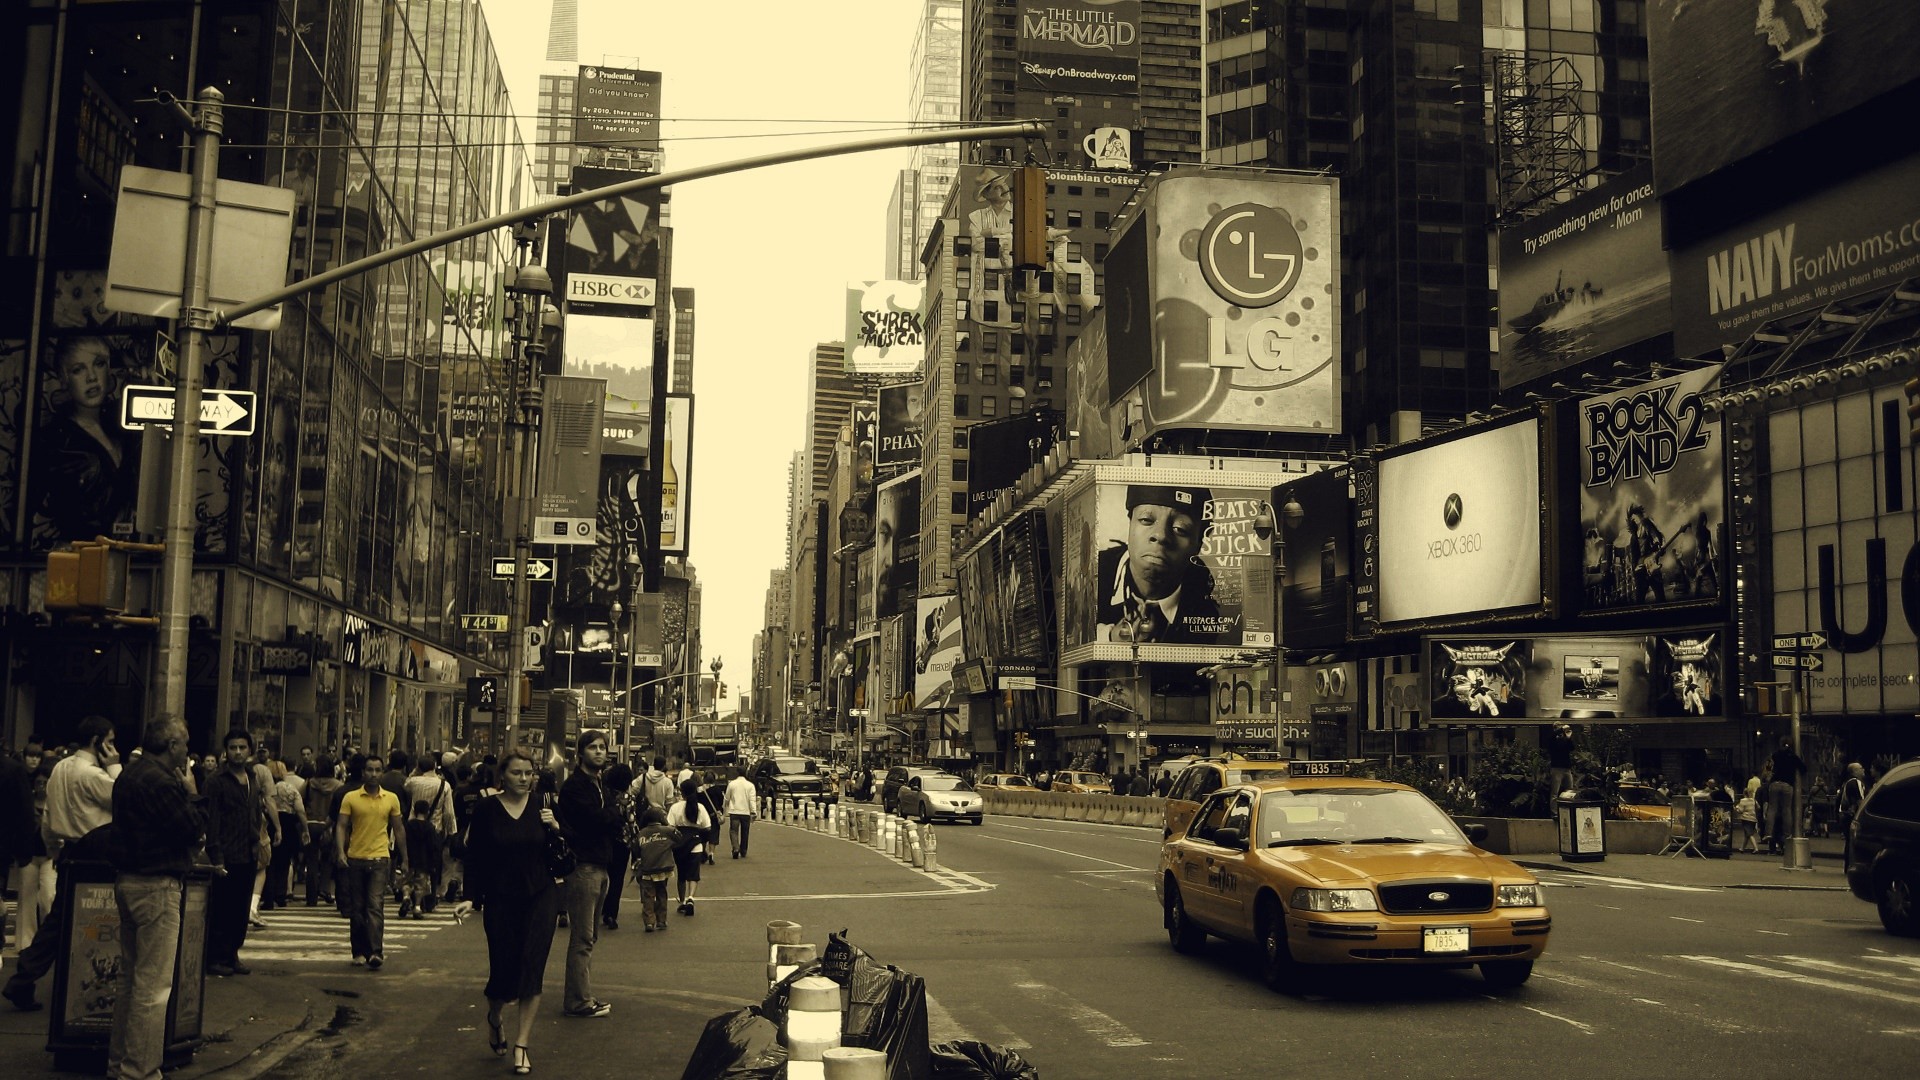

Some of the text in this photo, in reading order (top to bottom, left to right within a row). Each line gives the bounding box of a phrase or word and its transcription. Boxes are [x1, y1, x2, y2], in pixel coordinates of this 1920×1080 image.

[1046, 7, 1115, 25] THE LITTLE
[1023, 14, 1136, 51] MERMAID
[599, 70, 635, 81] Prudential
[588, 87, 603, 95] Did
[623, 91, 649, 99] know?
[582, 106, 592, 114] By
[613, 109, 631, 117] there
[1103, 173, 1141, 186] Coffee
[1523, 183, 1654, 255] Try something new for once.
[1616, 207, 1643, 230] Mom
[1707, 223, 1796, 316] NAVY
[571, 280, 623, 298] HSBC
[1717, 318, 1733, 331] You
[1733, 314, 1750, 328] gave
[1751, 306, 1770, 320] them
[1771, 301, 1785, 313] the
[1786, 293, 1813, 309] values.
[1814, 286, 1829, 299] We
[1829, 280, 1848, 296] give
[1849, 272, 1871, 287] them
[1872, 265, 1887, 278] the
[861, 310, 923, 335] SHREK
[864, 331, 922, 348] MUSICAL
[1208, 316, 1295, 372] LG
[144, 400, 234, 420] ONE WAY
[1585, 382, 1712, 454] ROCK 2
[1586, 428, 1680, 488] BAND
[972, 493, 986, 502] LIVE
[1201, 500, 1259, 521] BEATS
[1201, 533, 1263, 555] STICK
[1427, 532, 1482, 560] XBOX 360
[501, 564, 545, 575] ON WAY
[461, 615, 499, 630] W 44 ST
[1779, 636, 1822, 648] ONE WAY
[930, 661, 953, 673] maxell
[1777, 656, 1818, 667] ONE WAY
[1803, 675, 1825, 689] The
[1827, 672, 1878, 690] complete
[1305, 763, 1330, 775] 7B35
